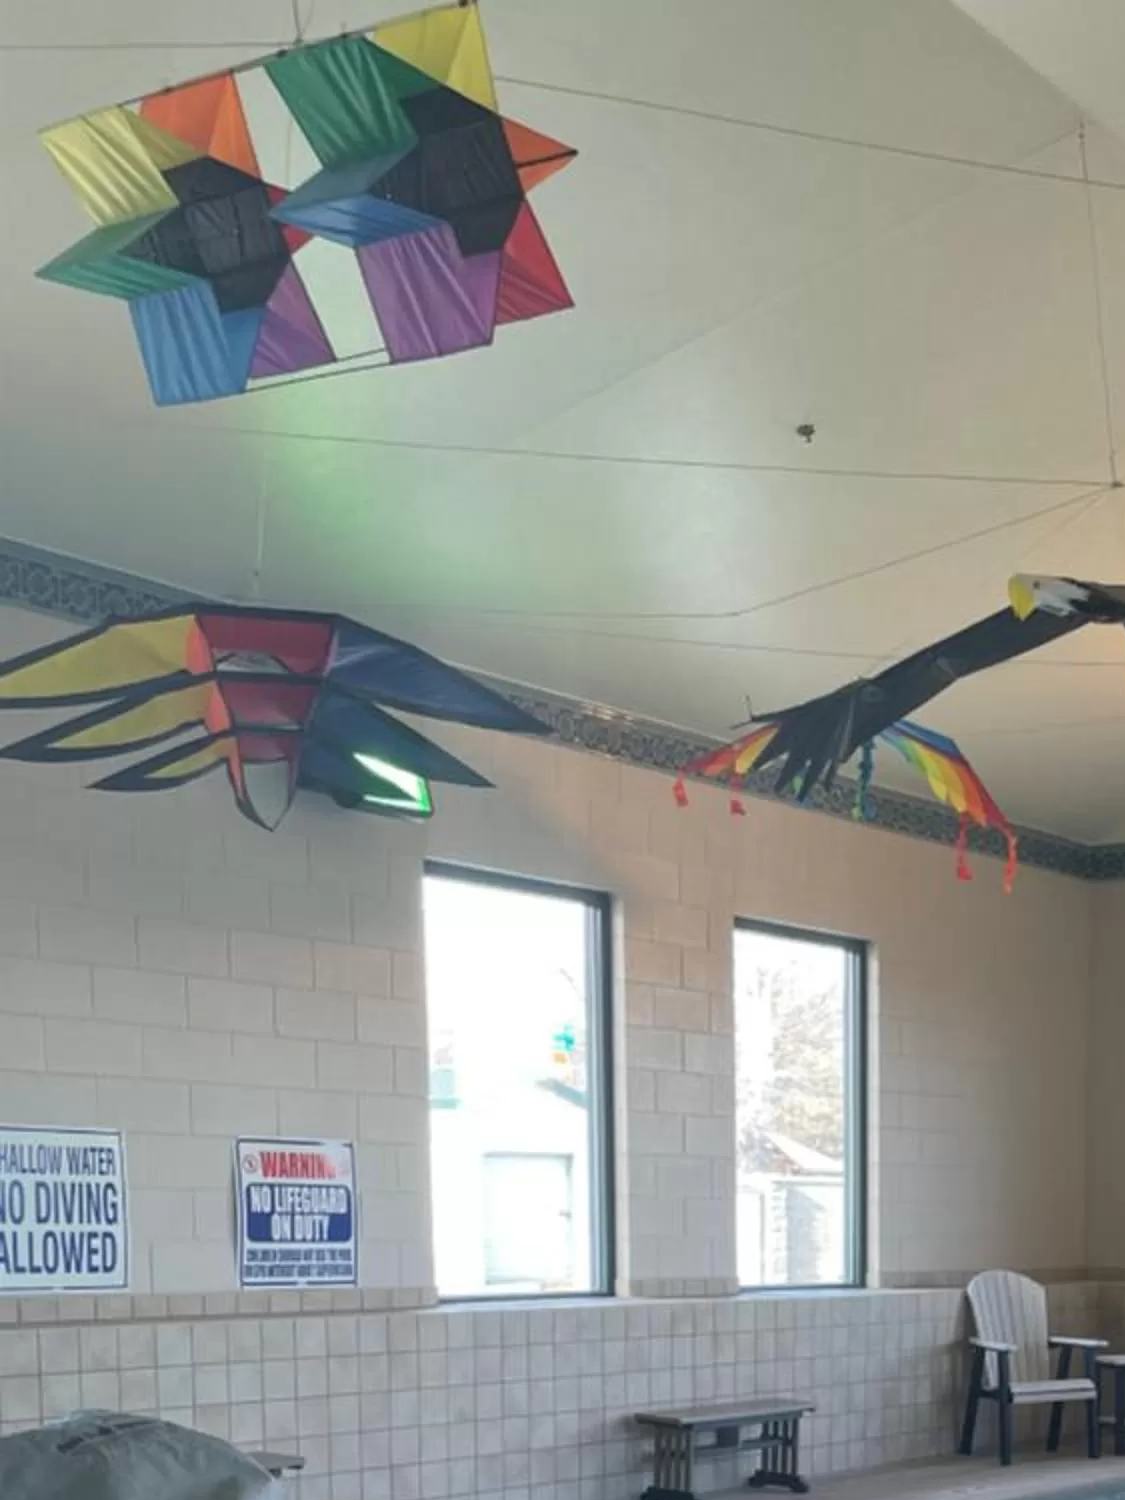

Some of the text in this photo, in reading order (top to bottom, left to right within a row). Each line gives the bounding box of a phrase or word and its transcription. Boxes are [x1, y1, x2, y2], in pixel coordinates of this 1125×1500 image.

[0, 1144, 117, 1176] HALLOW WATER
[35, 1181, 118, 1225] DIVING
[250, 1185, 348, 1214] NO LIFEGUARD
[271, 1215, 330, 1240] ON DUTY
[0, 1230, 118, 1274] ALLOWED
